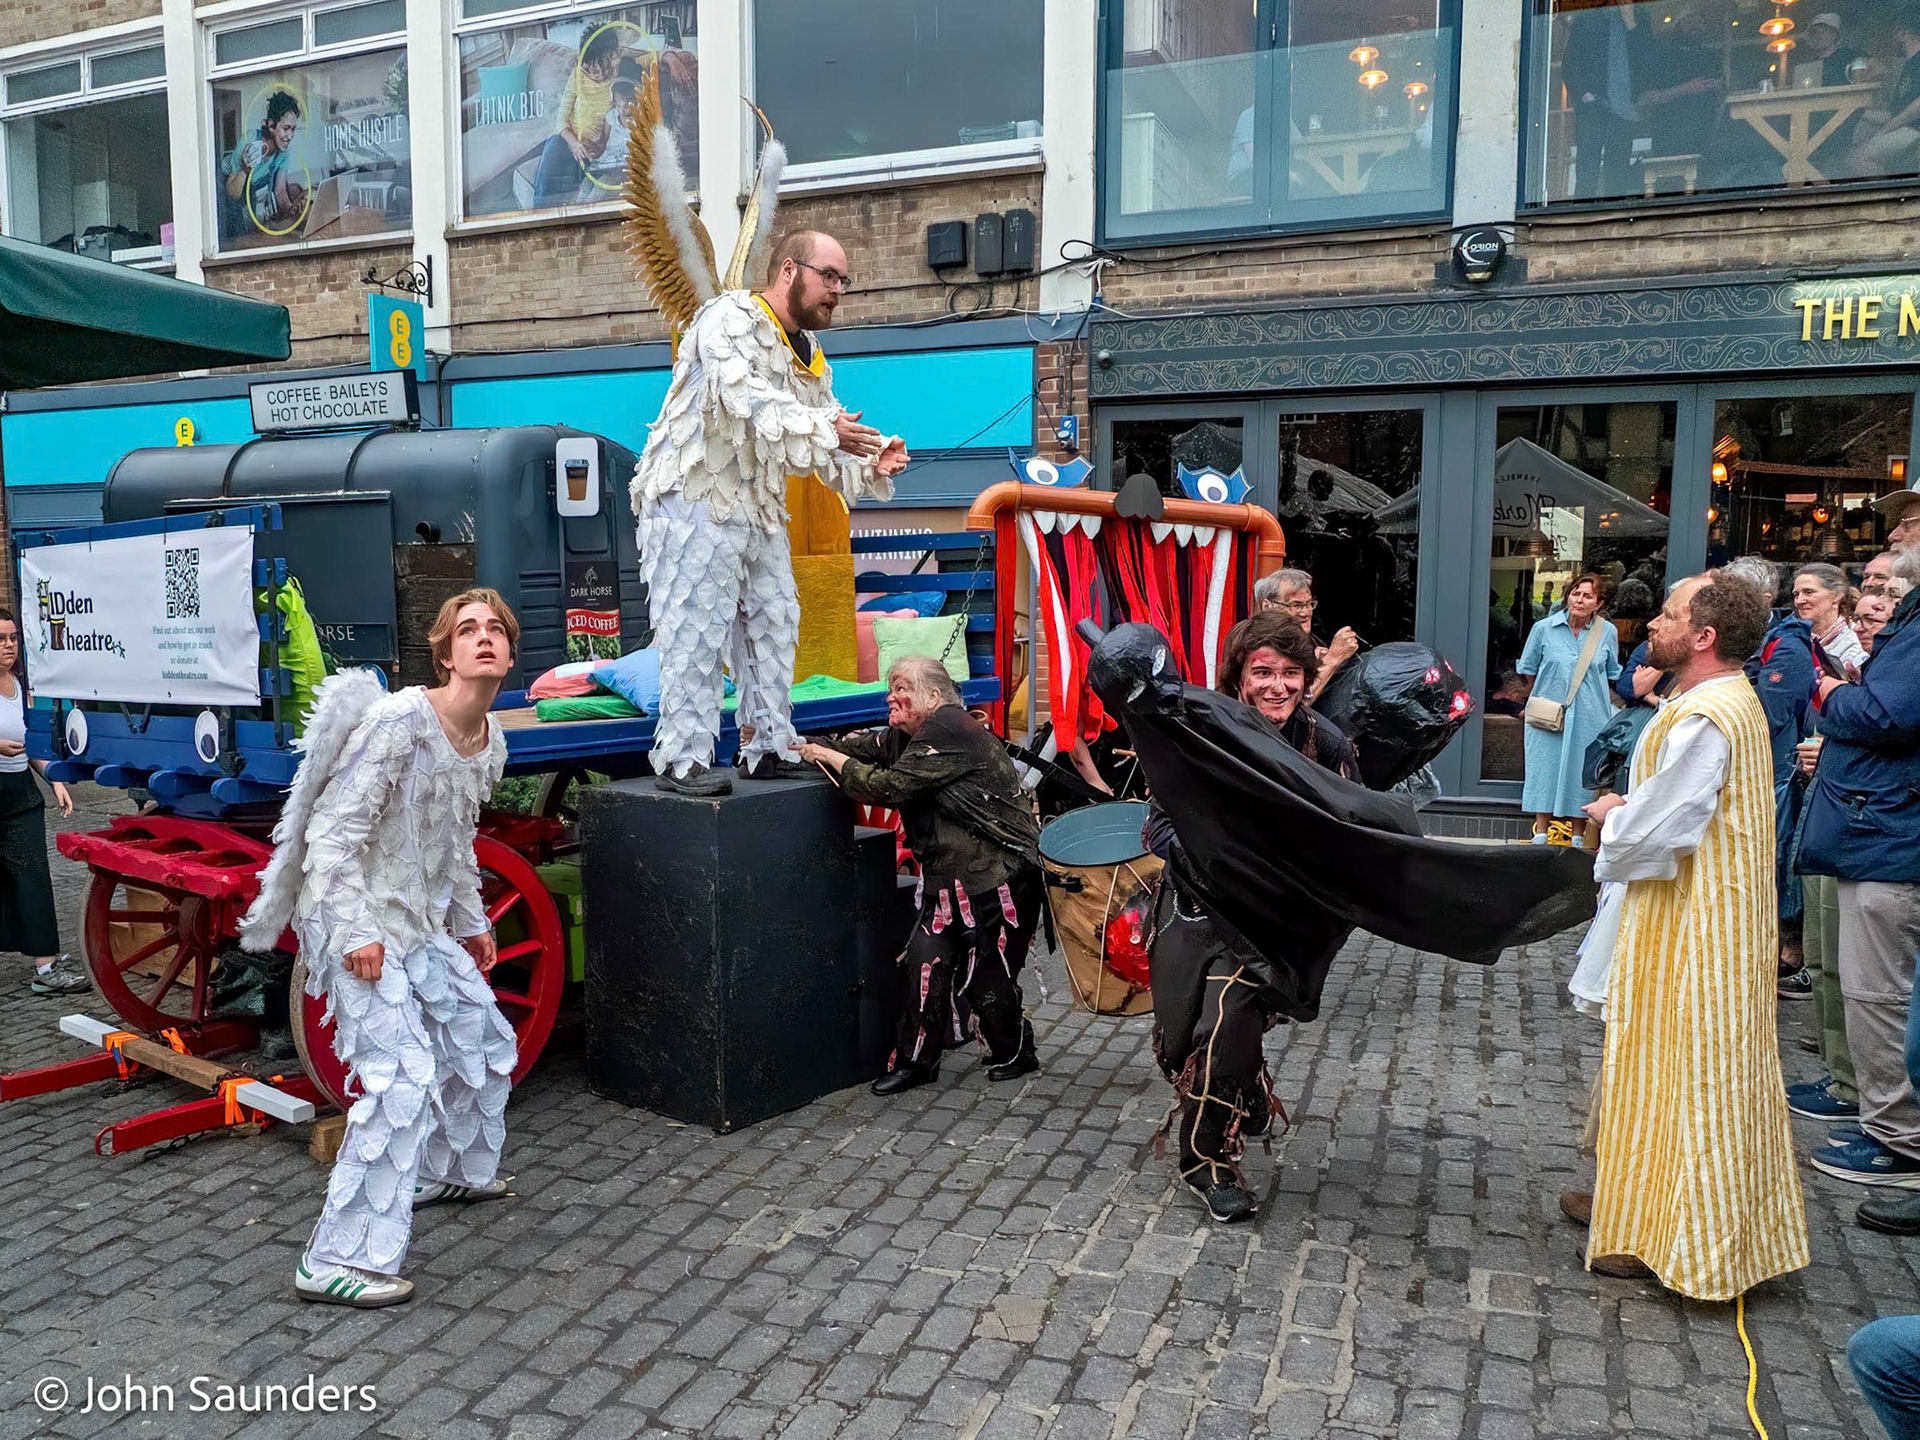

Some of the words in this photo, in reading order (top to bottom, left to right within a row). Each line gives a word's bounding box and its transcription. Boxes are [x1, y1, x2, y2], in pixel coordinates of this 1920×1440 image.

[473, 93, 516, 127] THINK
[520, 89, 544, 121] BIG
[324, 122, 355, 152] HOME
[358, 114, 404, 148] HUSTLE
[1470, 242, 1499, 251] ORION
[1795, 294, 1883, 341] THE
[266, 386, 322, 405] COFFEE
[329, 380, 389, 400] BAILEYS
[270, 406, 299, 423] HOT
[302, 399, 389, 420] CHOCOLATE
[570, 587, 588, 598] DARK
[590, 585, 612, 596] HORSE
[567, 615, 587, 630] ICED
[588, 615, 618, 631] COFFEE
